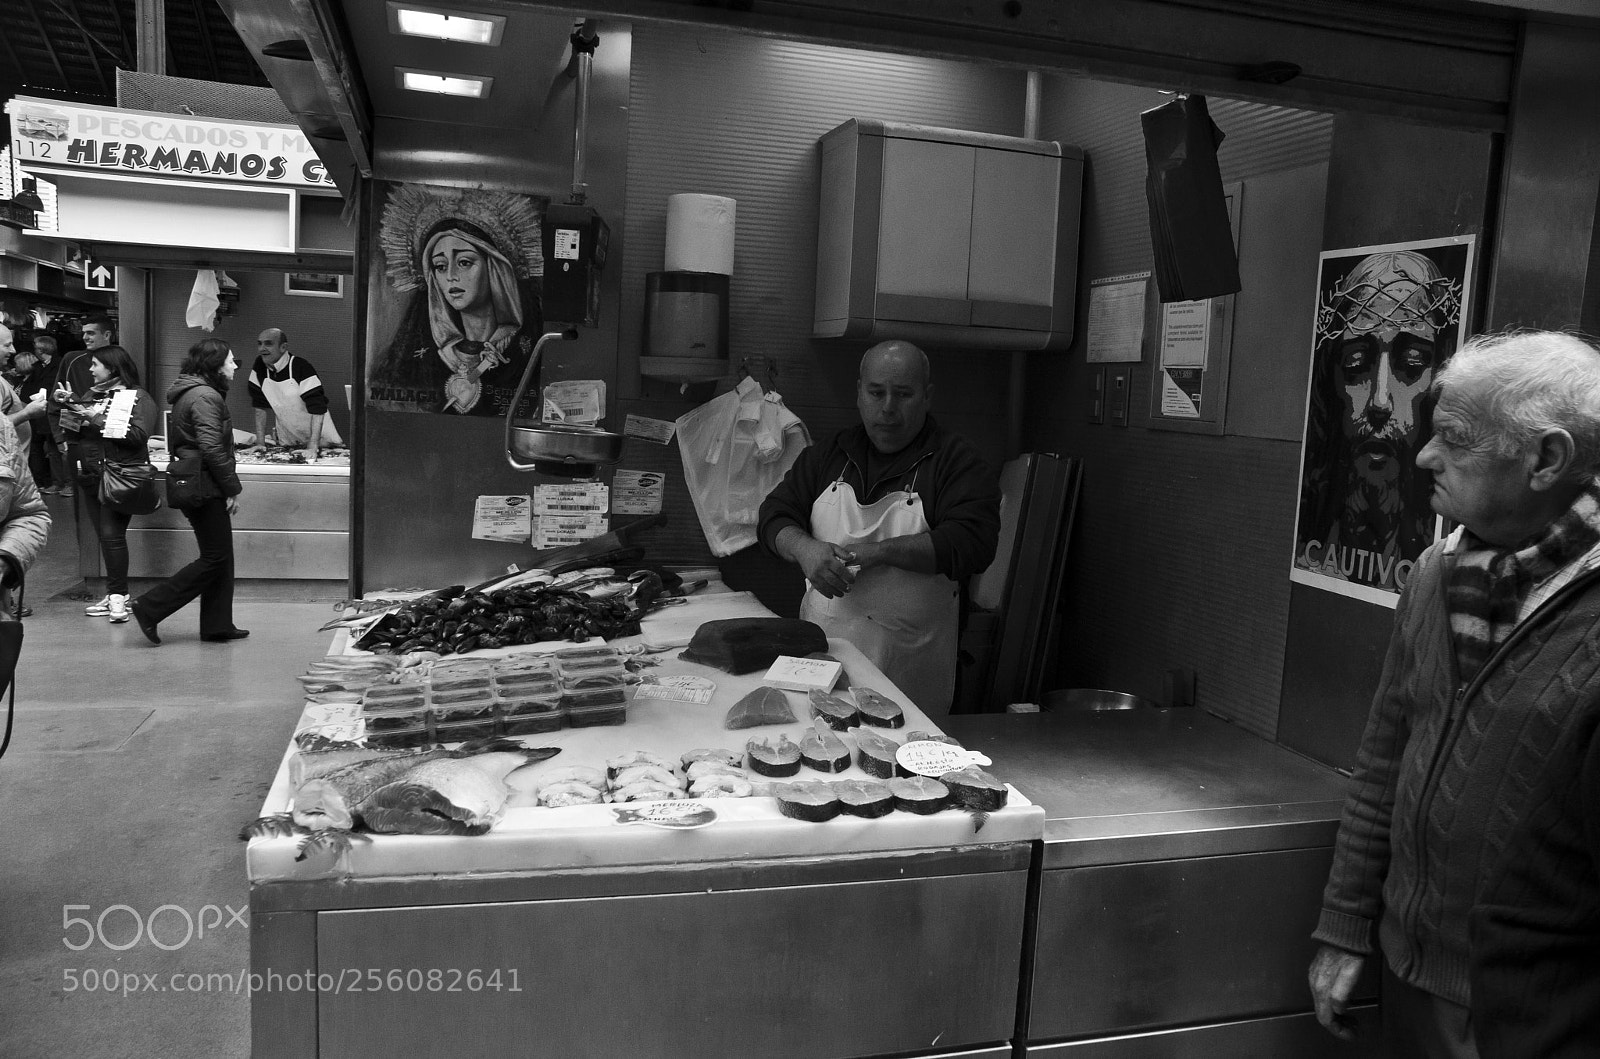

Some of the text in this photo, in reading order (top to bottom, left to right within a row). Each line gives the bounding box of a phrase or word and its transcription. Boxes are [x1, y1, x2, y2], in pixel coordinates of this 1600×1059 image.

[15, 139, 52, 159] 112
[77, 114, 314, 154] PESCADOS Y M
[66, 138, 288, 180] HERMANOS
[1305, 539, 1415, 591] CAUTIVO
